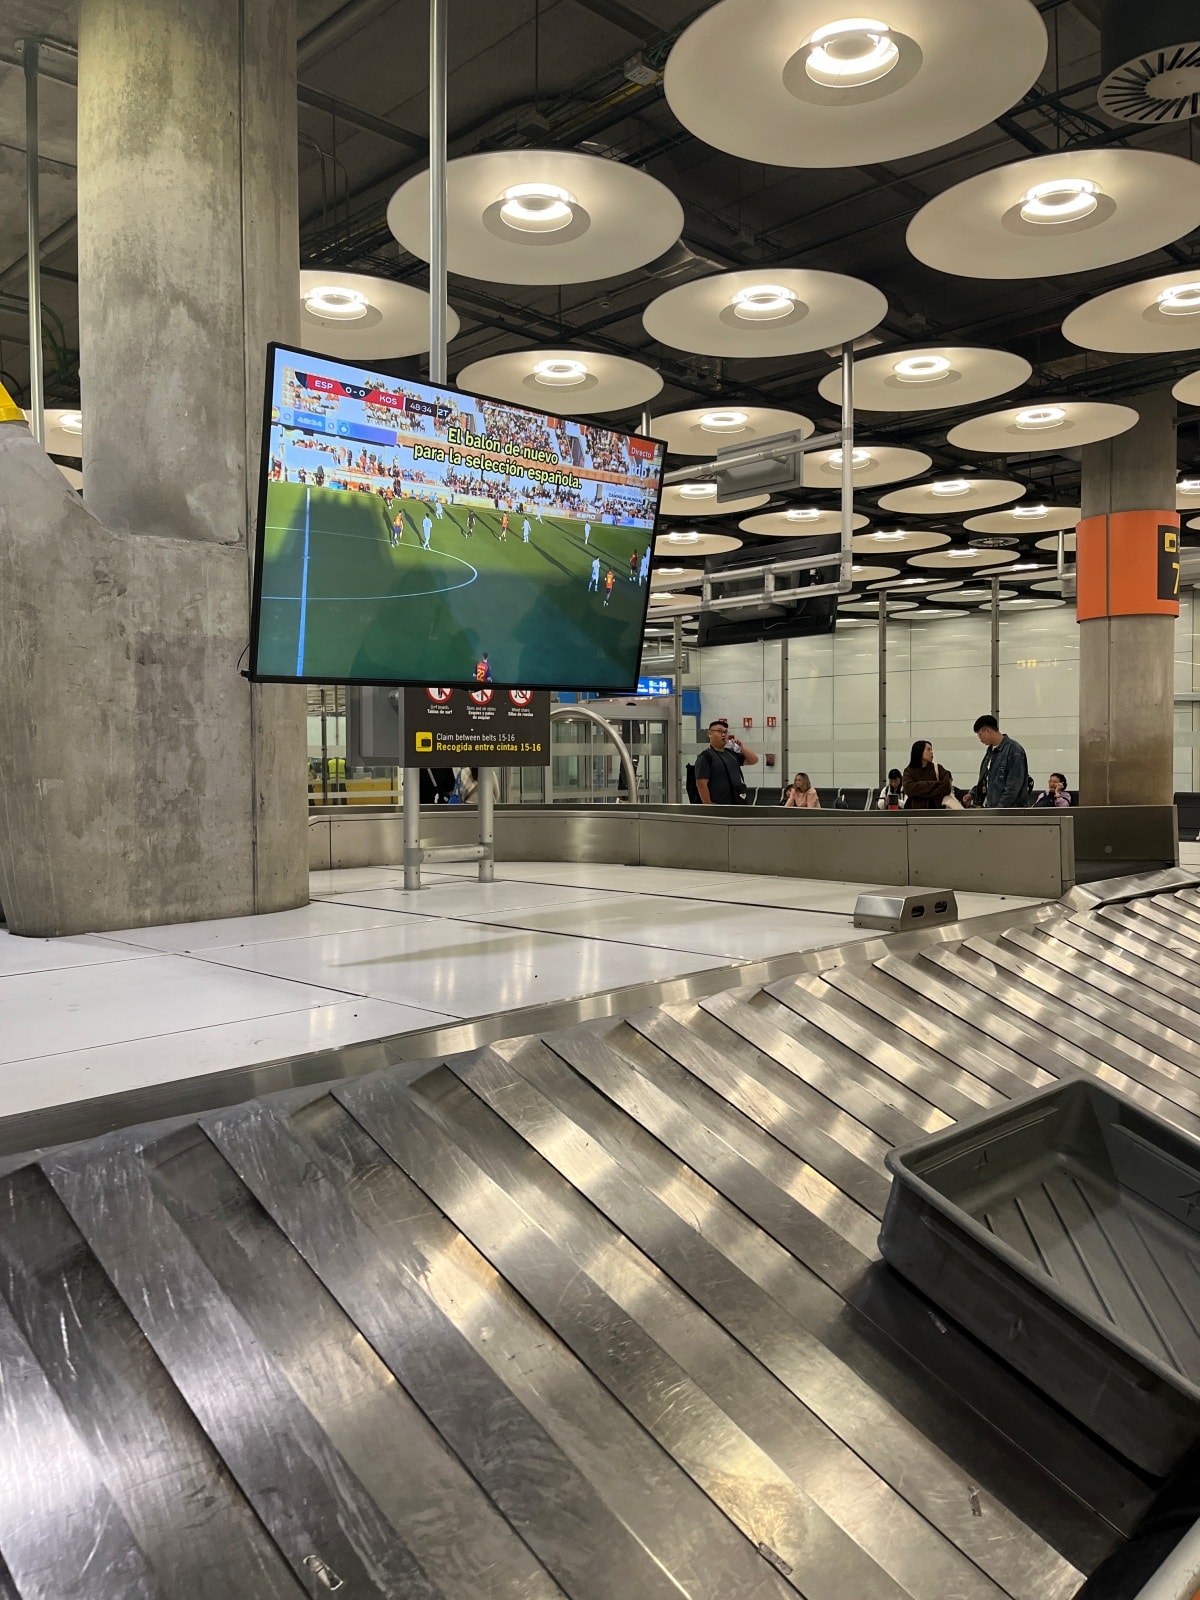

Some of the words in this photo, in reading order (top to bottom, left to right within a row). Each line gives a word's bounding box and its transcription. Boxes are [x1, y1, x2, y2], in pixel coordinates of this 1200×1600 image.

[314, 379, 334, 390] ESP
[379, 394, 398, 406] KOS
[438, 407, 449, 417] 2T
[448, 427, 462, 444] El
[465, 431, 500, 453] balón
[504, 442, 520, 457] de
[523, 449, 559, 466] nuevo
[631, 446, 652, 459] Directo
[413, 443, 445, 462] para
[449, 447, 462, 465] la
[465, 453, 525, 478] selección
[527, 467, 583, 489] española.
[436, 732, 454, 742] Claim
[455, 733, 480, 742] between
[482, 733, 497, 742] belts
[498, 733, 516, 742] 15-16
[436, 742, 473, 752] Recogida
[475, 743, 495, 752] entre
[496, 743, 518, 752] cintas
[520, 743, 542, 752] 15-16
